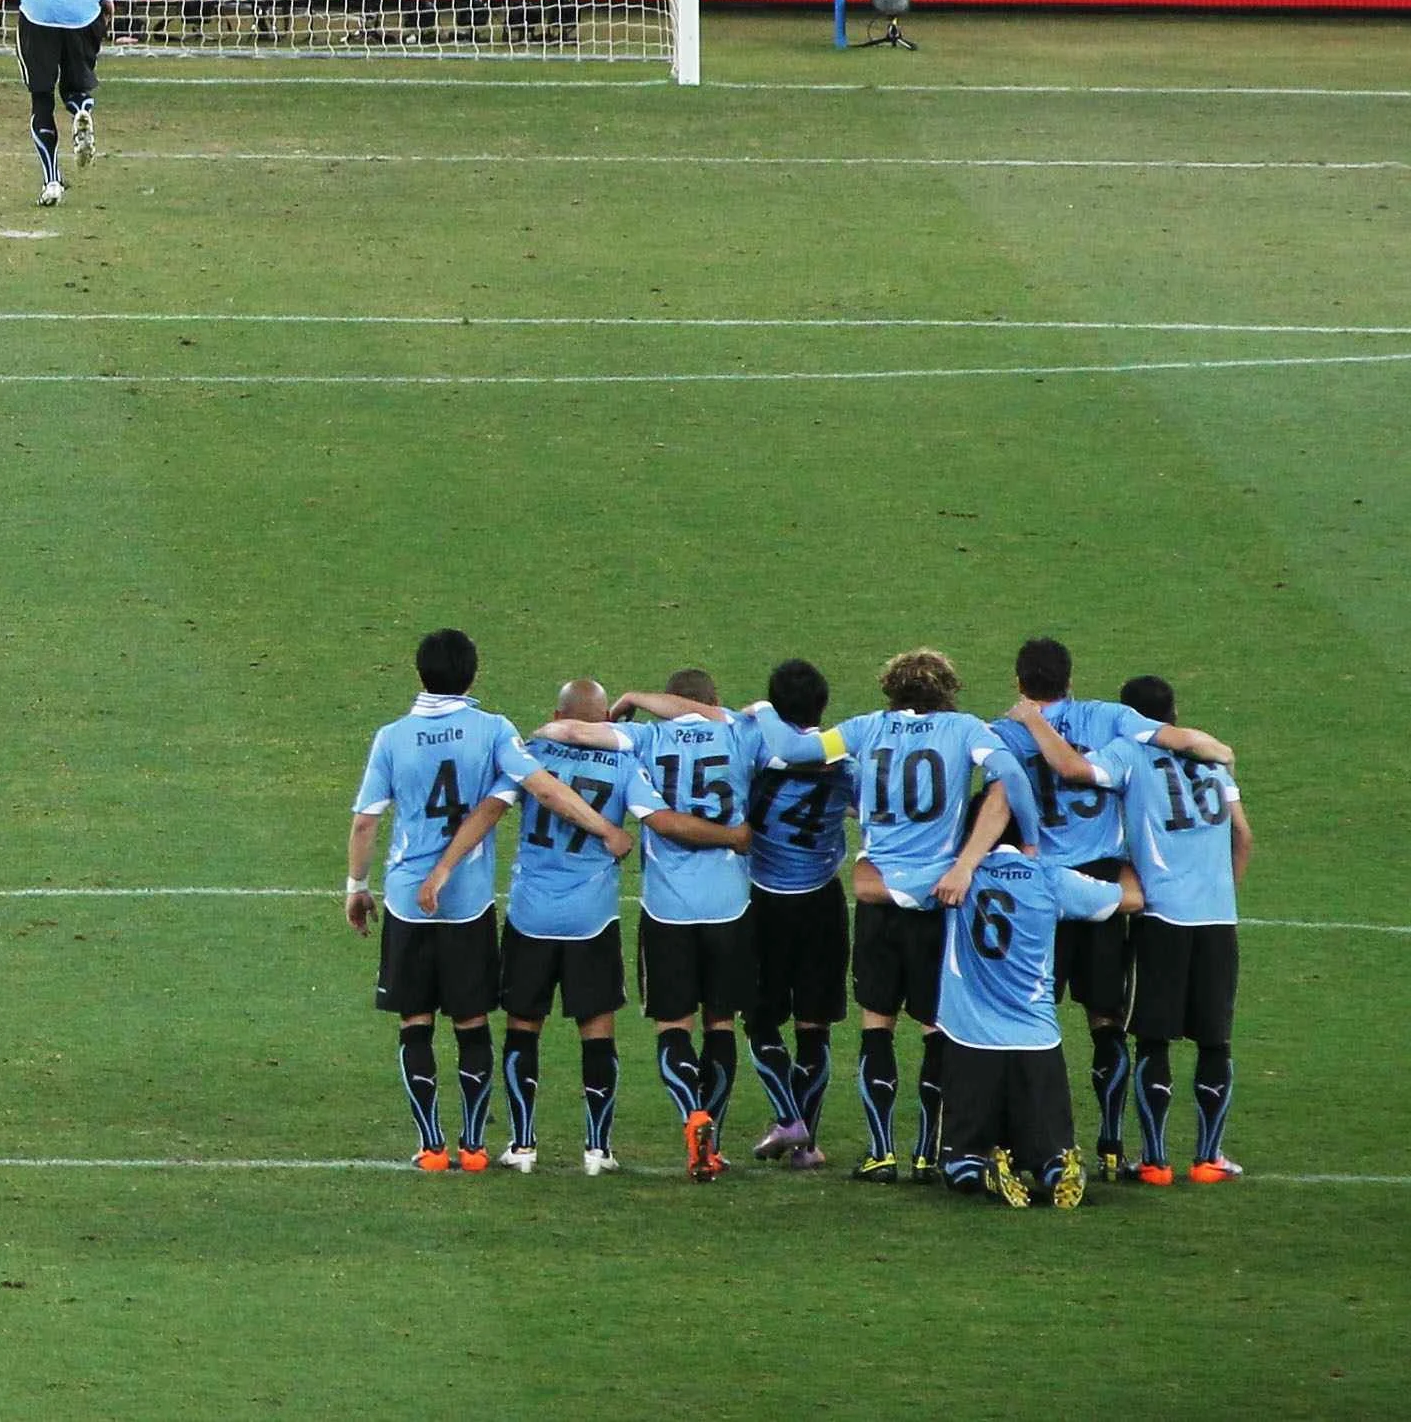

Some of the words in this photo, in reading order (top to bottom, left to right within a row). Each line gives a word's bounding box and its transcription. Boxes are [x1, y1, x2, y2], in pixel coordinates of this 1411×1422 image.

[425, 759, 469, 838] 4
[655, 754, 735, 823] 15
[870, 748, 947, 826] 10
[1154, 756, 1231, 832] 16
[972, 888, 1015, 960] 6
